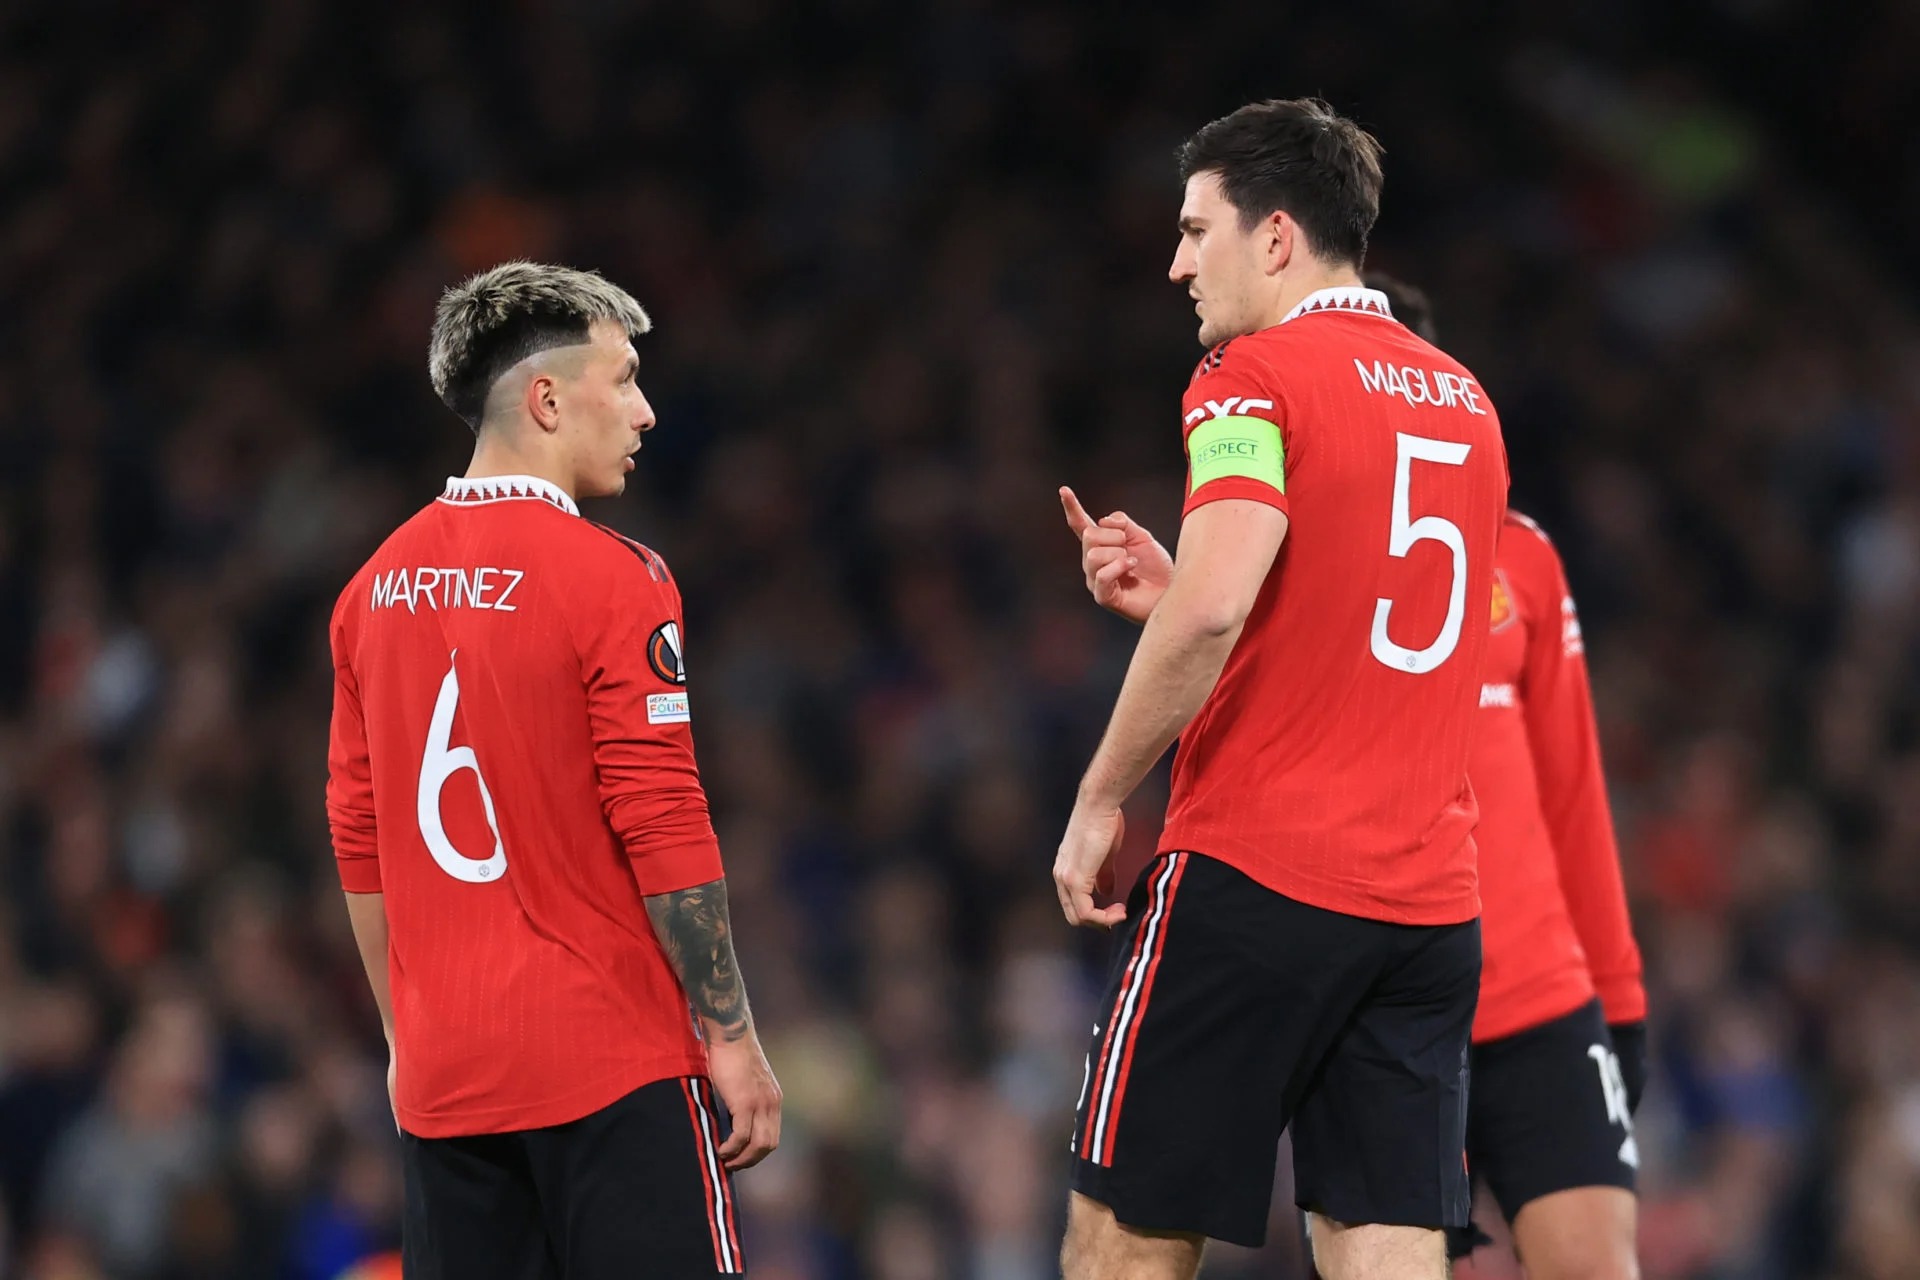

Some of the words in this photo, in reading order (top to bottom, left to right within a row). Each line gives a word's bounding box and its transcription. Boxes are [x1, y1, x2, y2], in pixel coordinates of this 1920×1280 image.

[1353, 357, 1487, 416] MAGUIRE
[1197, 442, 1259, 465] RESPECT
[1369, 431, 1473, 675] 5
[371, 566, 524, 616] MARTINEZ
[416, 647, 508, 884] 6
